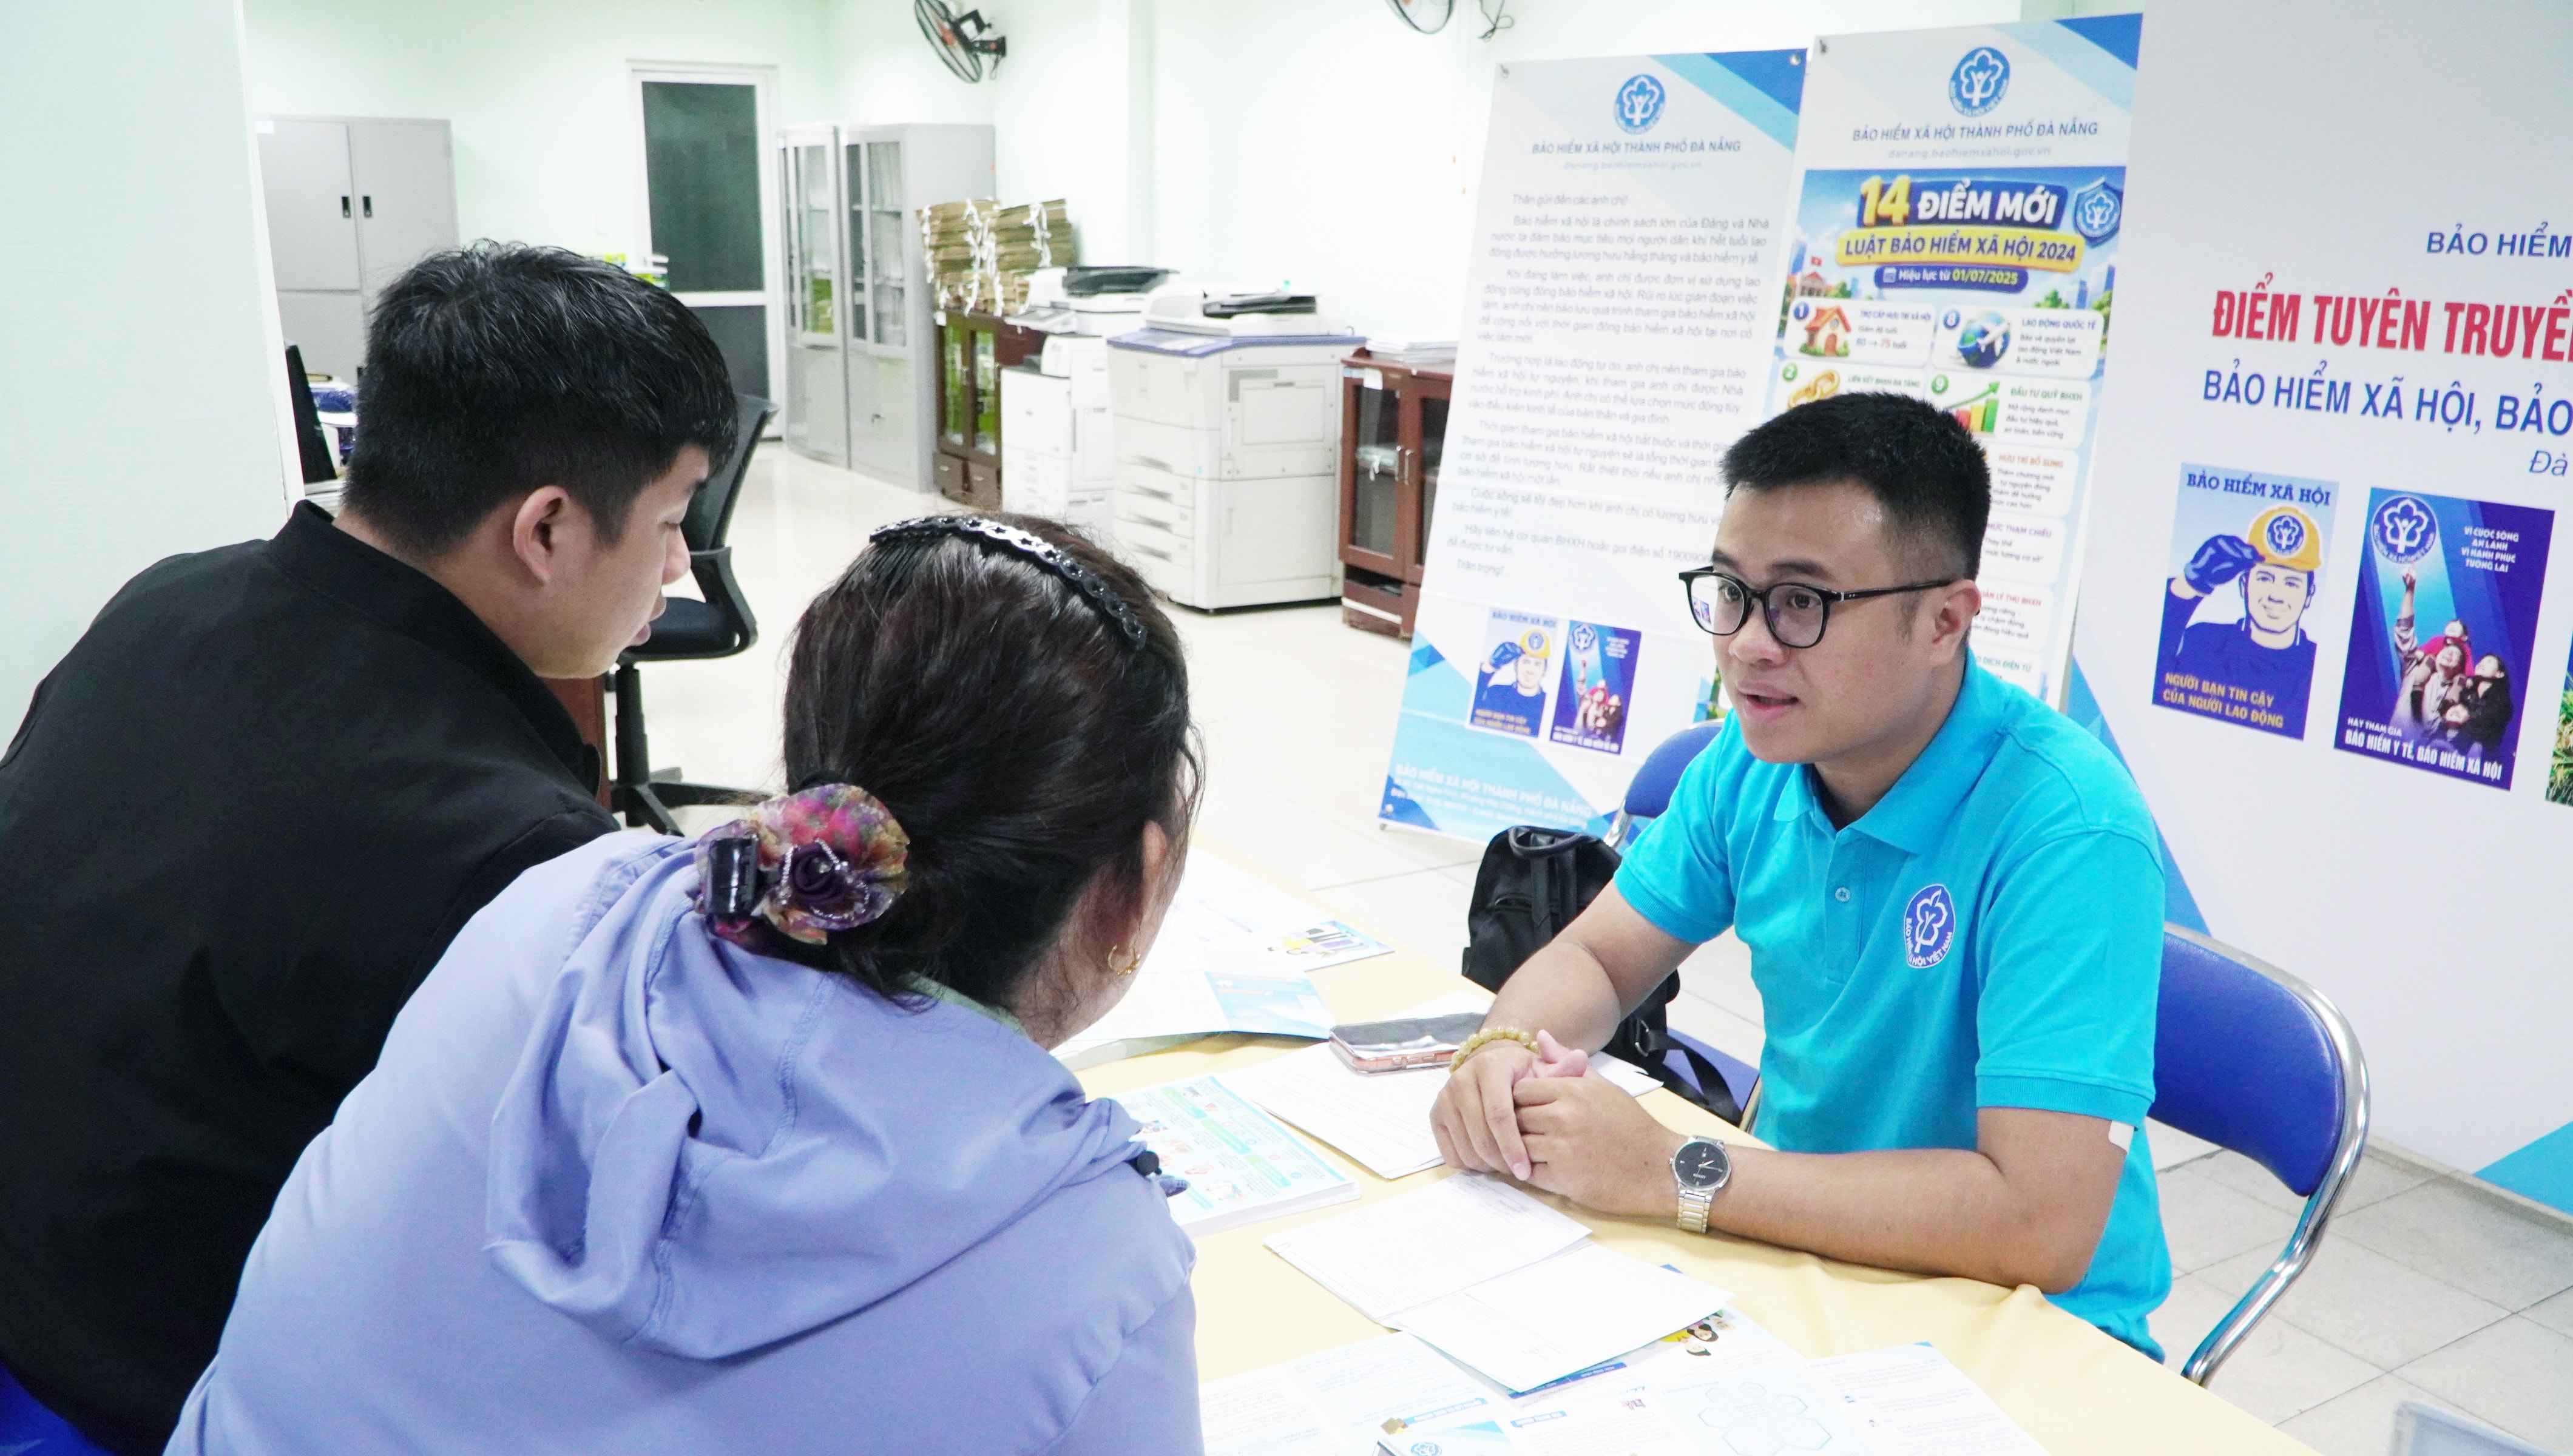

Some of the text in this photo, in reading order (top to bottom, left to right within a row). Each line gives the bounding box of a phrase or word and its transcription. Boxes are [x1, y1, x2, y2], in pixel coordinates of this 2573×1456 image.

[1853, 124, 1878, 141] BẢO
[1881, 122, 1910, 140] HIỂM
[1915, 125, 1930, 140] XÃ
[1934, 124, 1955, 142] HỘI
[1960, 123, 2002, 139] THÀNH
[2006, 118, 2034, 137] PHỐ
[2037, 120, 2055, 136] ĐÀ
[1860, 175, 1911, 226] 14
[1918, 178, 1992, 220] ĐIỂM
[1995, 185, 2058, 224] MỚI
[1845, 229, 2077, 262] LUẬT BẢO HIỂM XÃ HỘI 2024
[2427, 221, 2572, 257] BẢO HIỂM
[2213, 272, 2573, 362] ĐIỂM TUYÊN TRUYỀ
[2203, 359, 2573, 436] BẢO HIỂM XÃ HỘI, BẢO
[2529, 450, 2568, 476] Đà
[2186, 469, 2220, 490] BẢO
[2223, 473, 2267, 497] HIỂM
[2298, 485, 2331, 507] HỘI
[2472, 538, 2485, 547] AN
[2495, 562, 2509, 573] LAI
[2163, 687, 2284, 729] CỦA NGƯỜI LAO ĐỘNG
[2364, 720, 2387, 734] THAM
[2387, 727, 2402, 737] GIA
[2344, 728, 2365, 747] BẢO
[2365, 733, 2392, 754] HIỂM
[2393, 740, 2401, 757] Y
[2416, 744, 2438, 765] BẢO
[2438, 748, 2466, 772] HIỂM
[2482, 760, 2503, 781] HỘI
[1912, 956, 1926, 966] HỘI
[1926, 948, 1943, 965] VIỆT
[1942, 931, 1953, 953] NAM
